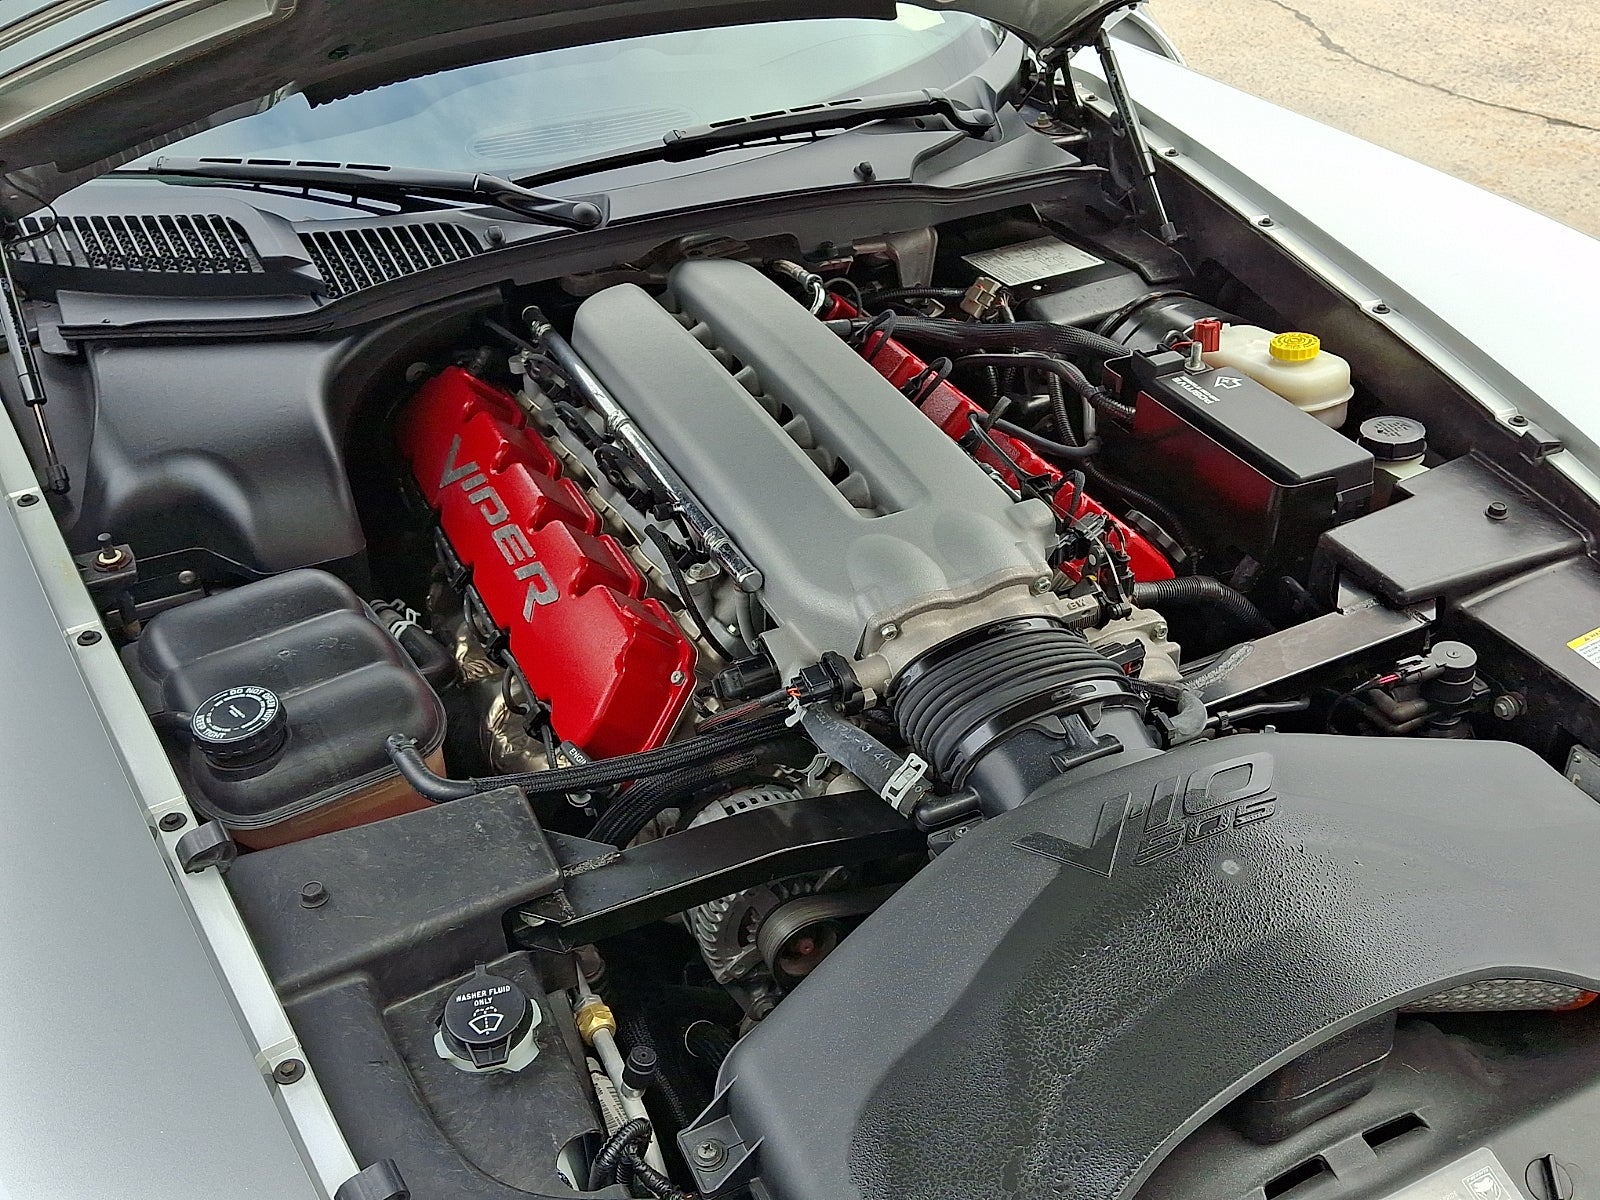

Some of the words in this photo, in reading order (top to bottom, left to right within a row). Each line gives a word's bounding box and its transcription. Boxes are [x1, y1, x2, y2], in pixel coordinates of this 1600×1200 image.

[439, 434, 560, 623] VIPER
[262, 692, 275, 708] OPEN
[261, 709, 274, 721] HOT
[1011, 751, 1274, 879] V10
[456, 990, 486, 1002] WASHER
[489, 986, 511, 995] FLUID
[474, 997, 493, 1006] ONLY
